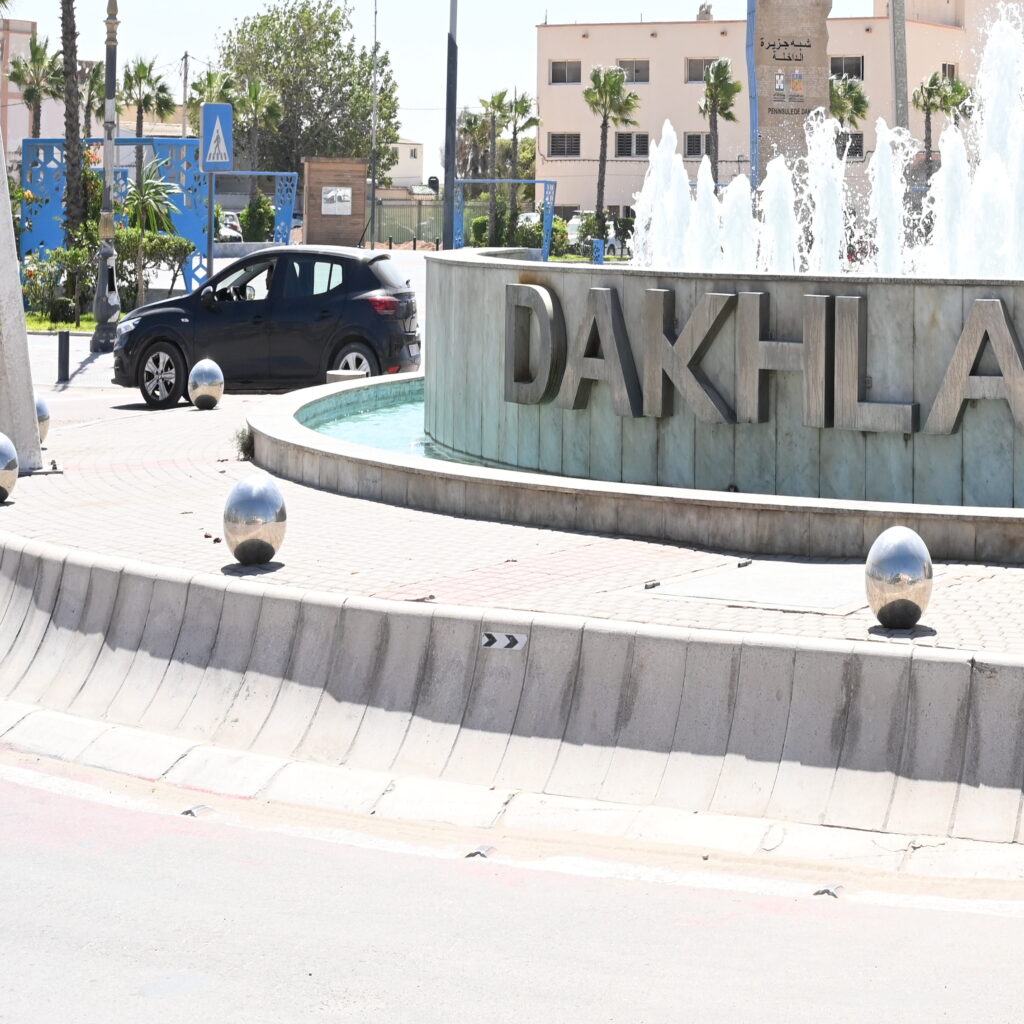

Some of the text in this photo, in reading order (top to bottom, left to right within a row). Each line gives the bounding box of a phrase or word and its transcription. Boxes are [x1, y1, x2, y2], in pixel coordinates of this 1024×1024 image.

[760, 38, 812, 51] شبه جزيرة
[773, 50, 804, 62] الداخلة
